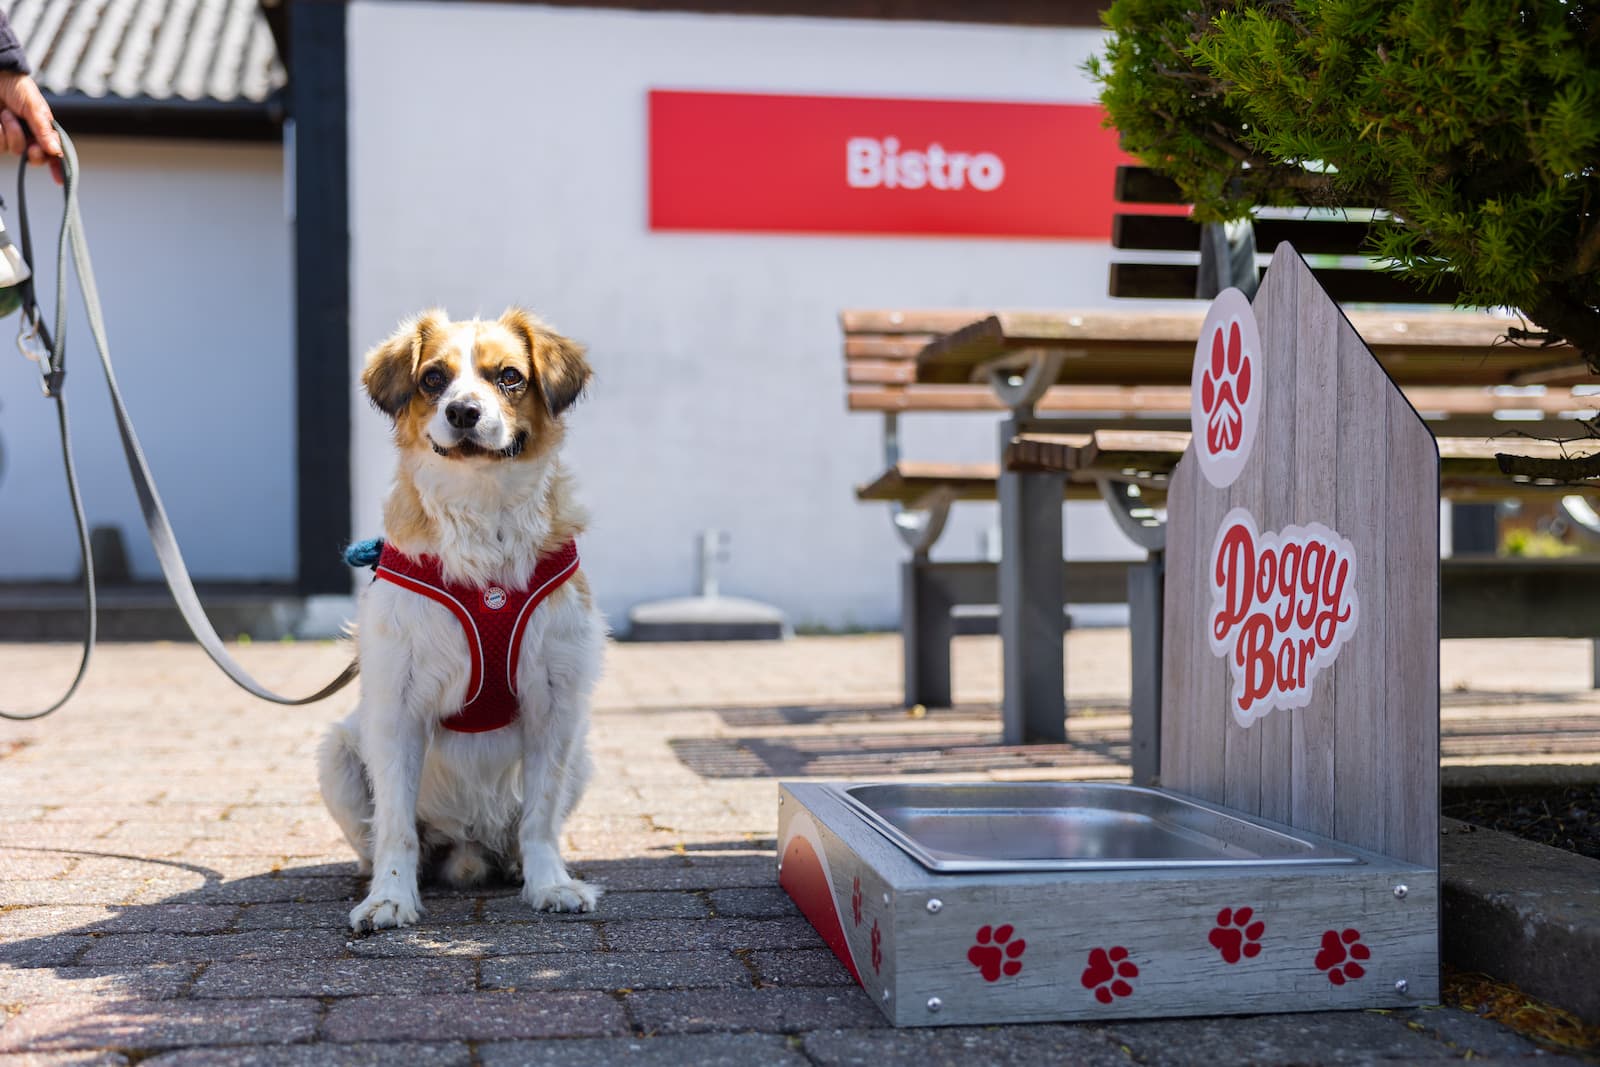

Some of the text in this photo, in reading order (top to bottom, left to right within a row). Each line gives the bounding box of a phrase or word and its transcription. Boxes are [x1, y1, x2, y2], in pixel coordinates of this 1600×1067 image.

[846, 136, 1005, 191] Bistro
[1215, 525, 1351, 648] Doggy
[1238, 613, 1315, 710] Bar
